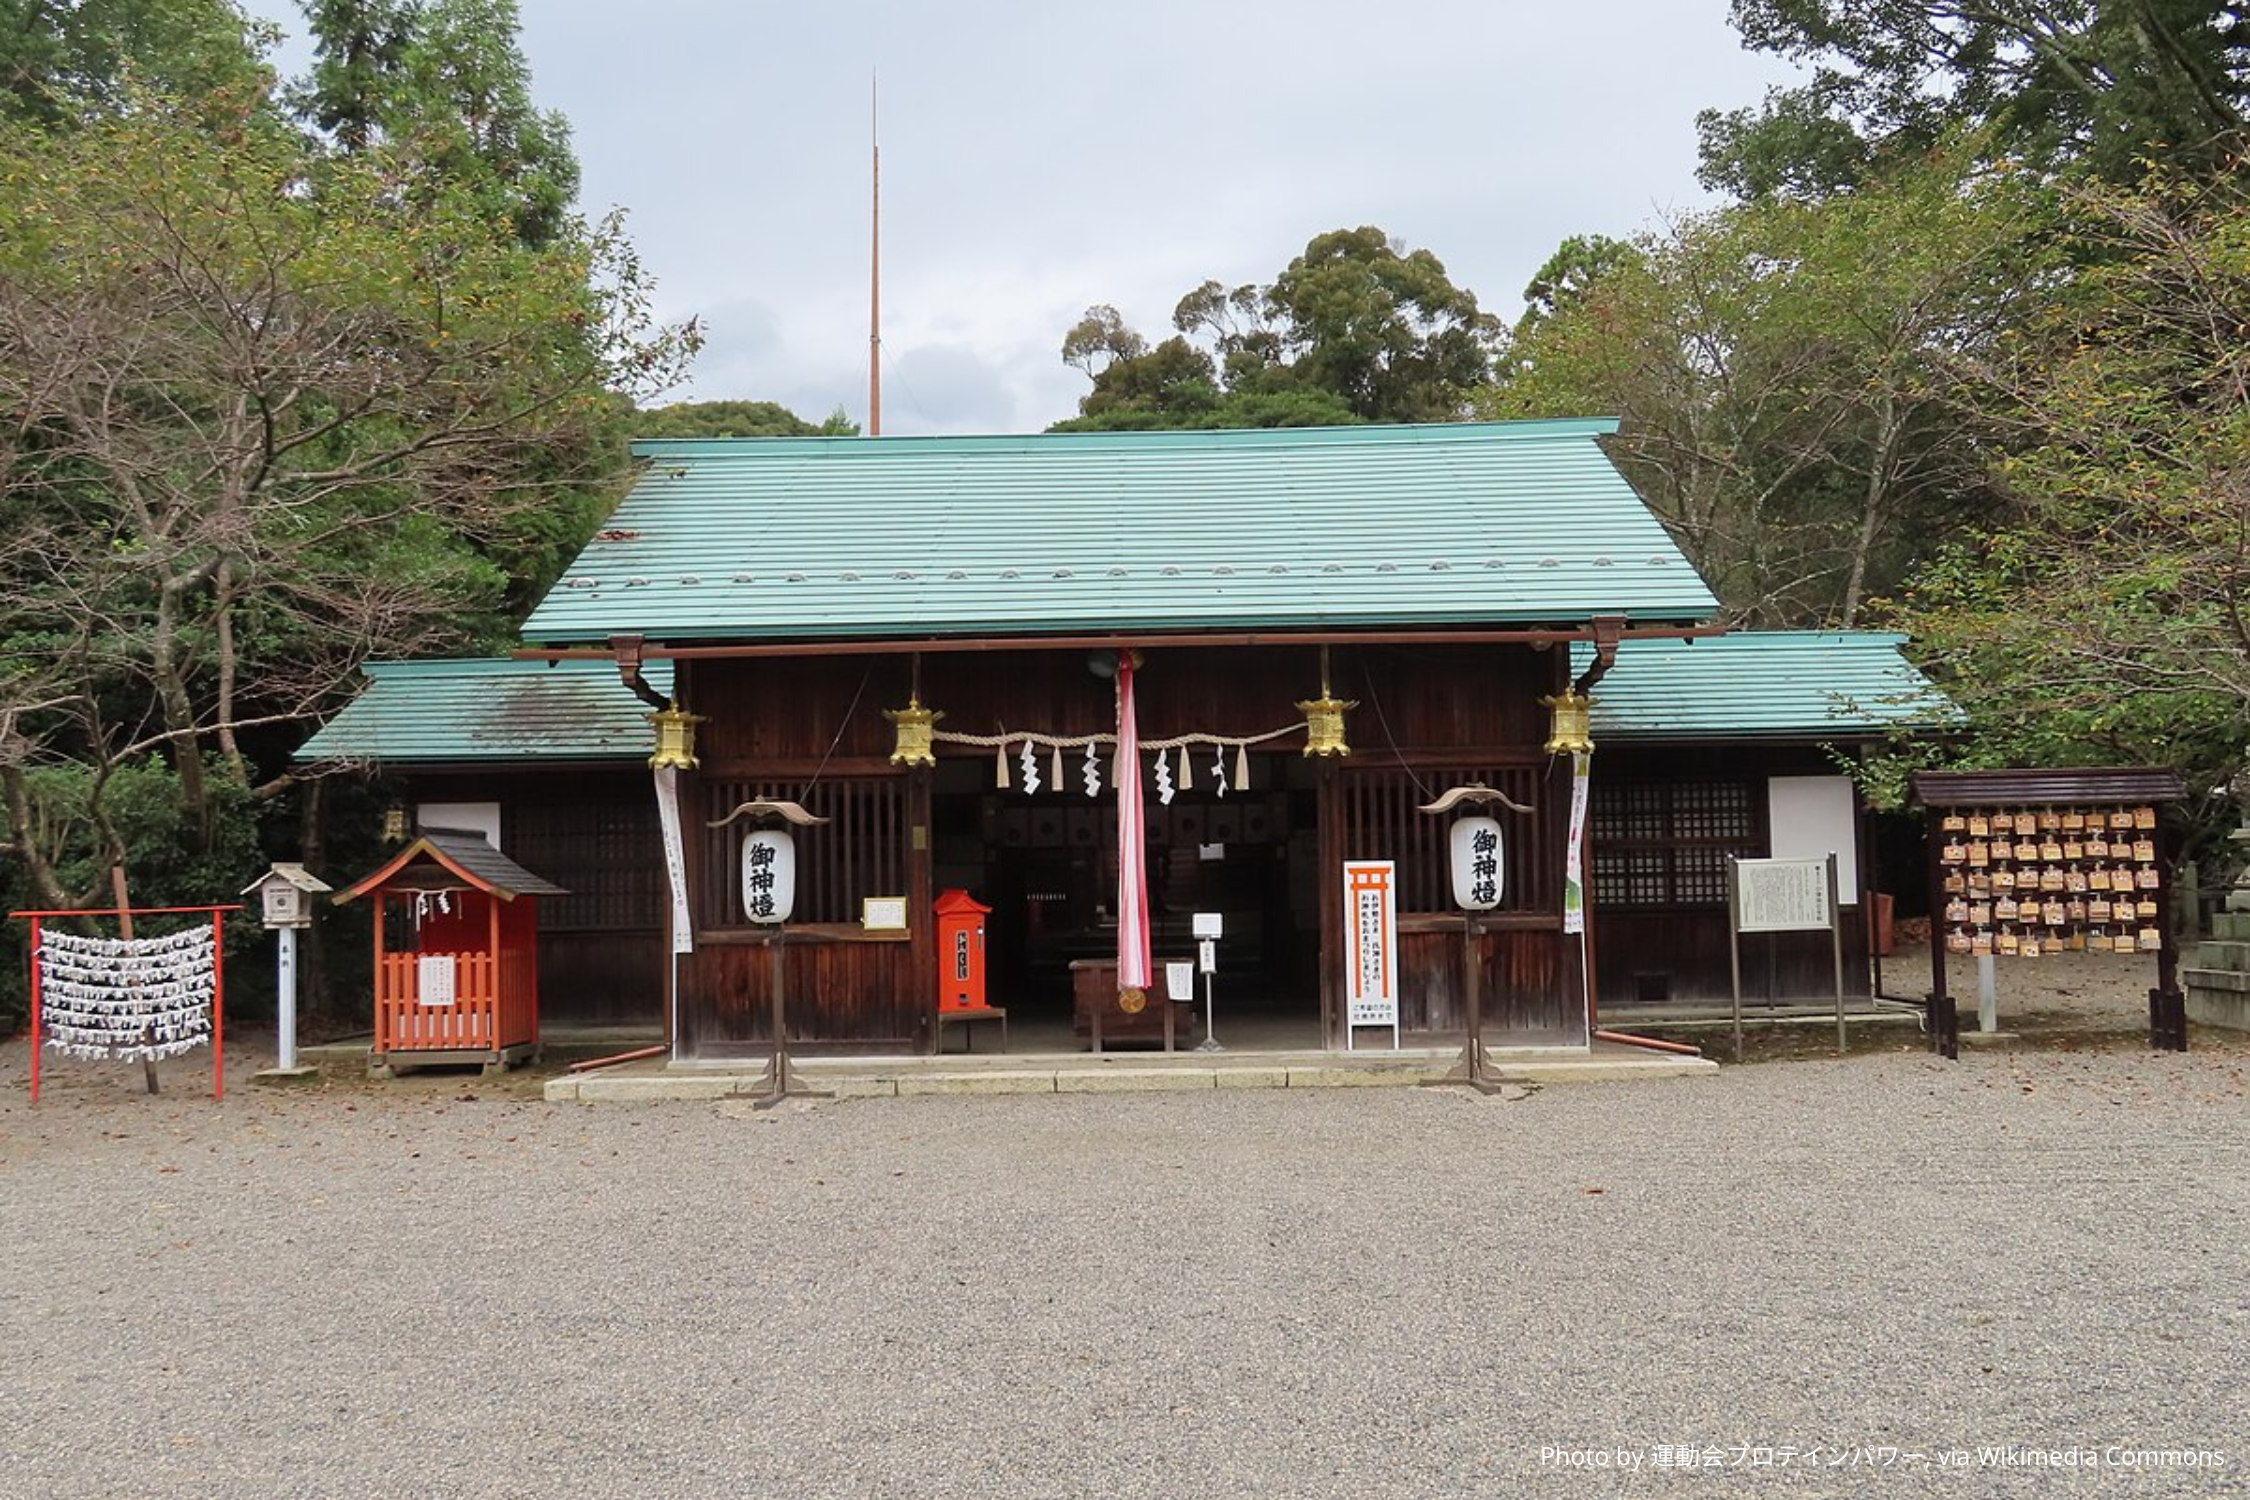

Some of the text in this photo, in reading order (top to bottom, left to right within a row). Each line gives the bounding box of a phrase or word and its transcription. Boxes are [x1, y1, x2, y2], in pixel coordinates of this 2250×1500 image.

[749, 842, 776, 918] 御神燈
[1471, 828, 1498, 904] 御神燈
